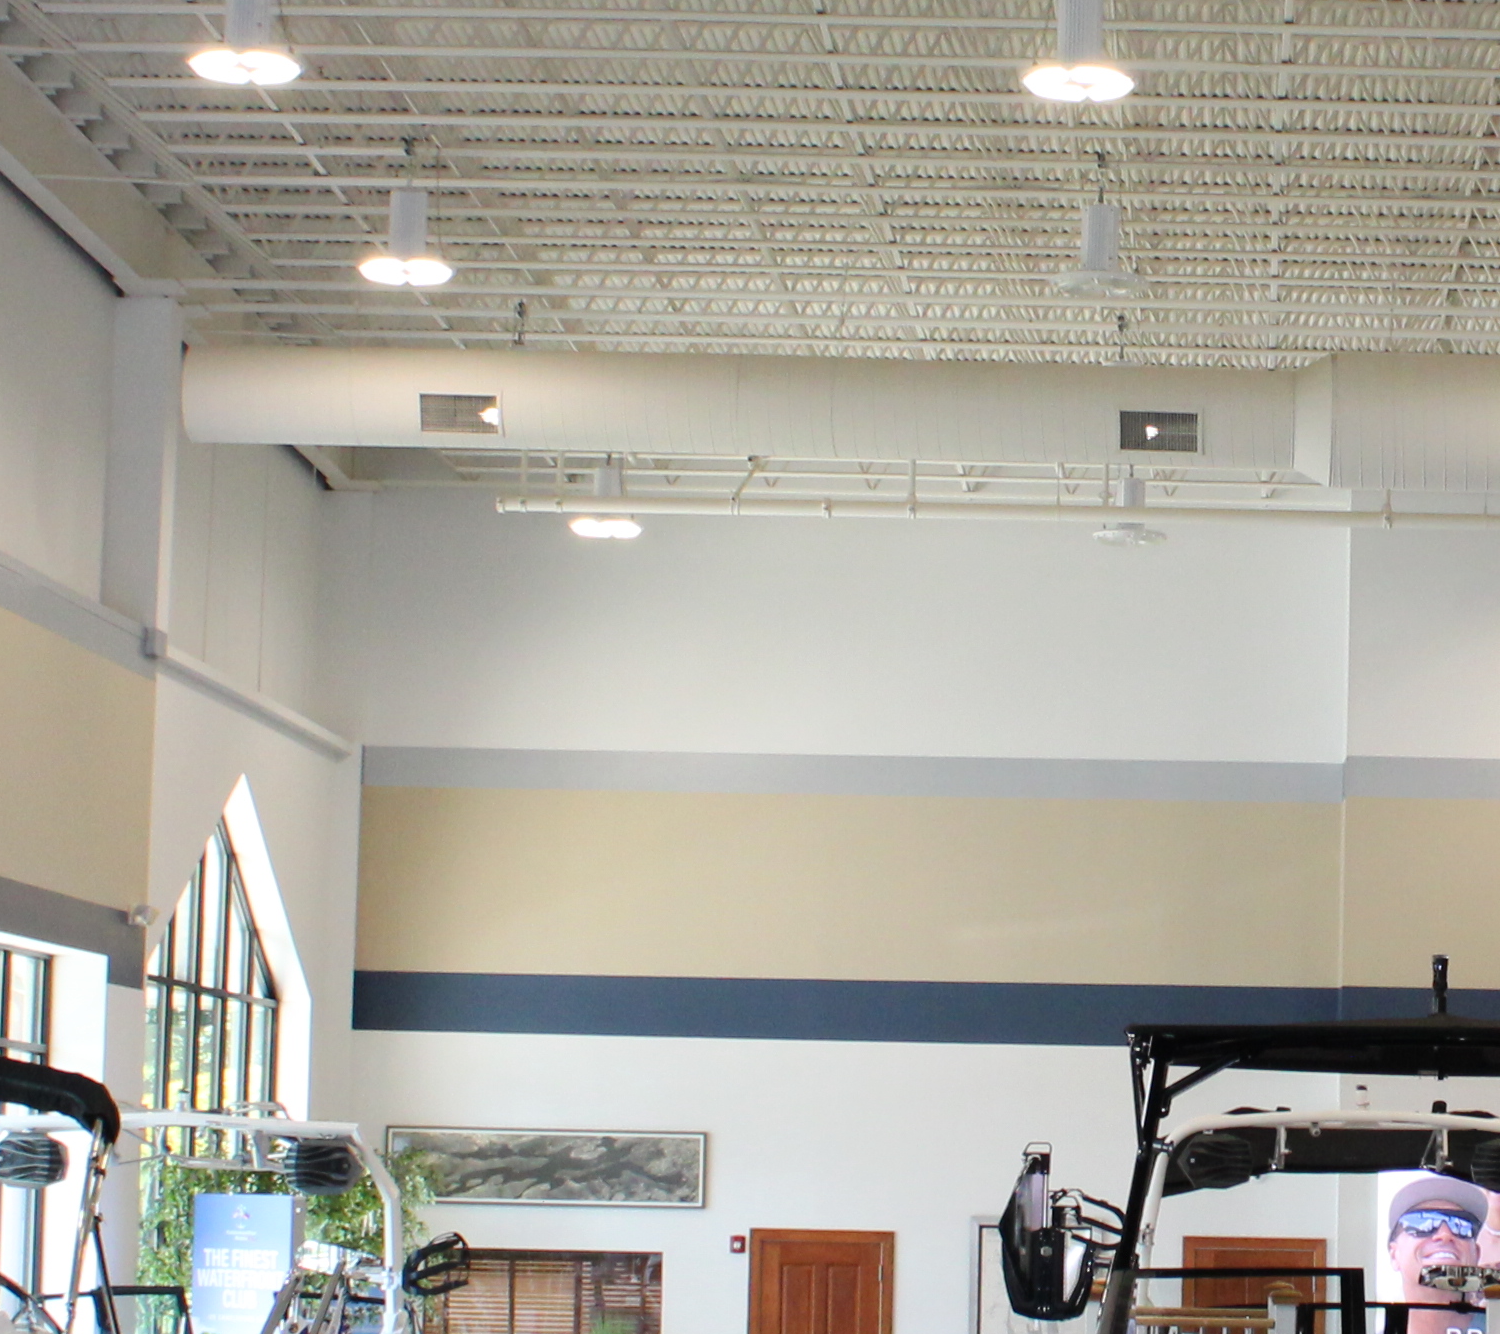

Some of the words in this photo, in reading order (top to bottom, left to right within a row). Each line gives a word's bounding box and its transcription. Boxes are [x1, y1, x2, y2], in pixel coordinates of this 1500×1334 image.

[203, 1248, 229, 1267] THE
[231, 1249, 279, 1270] FINEST
[222, 1289, 258, 1309] CLUB
